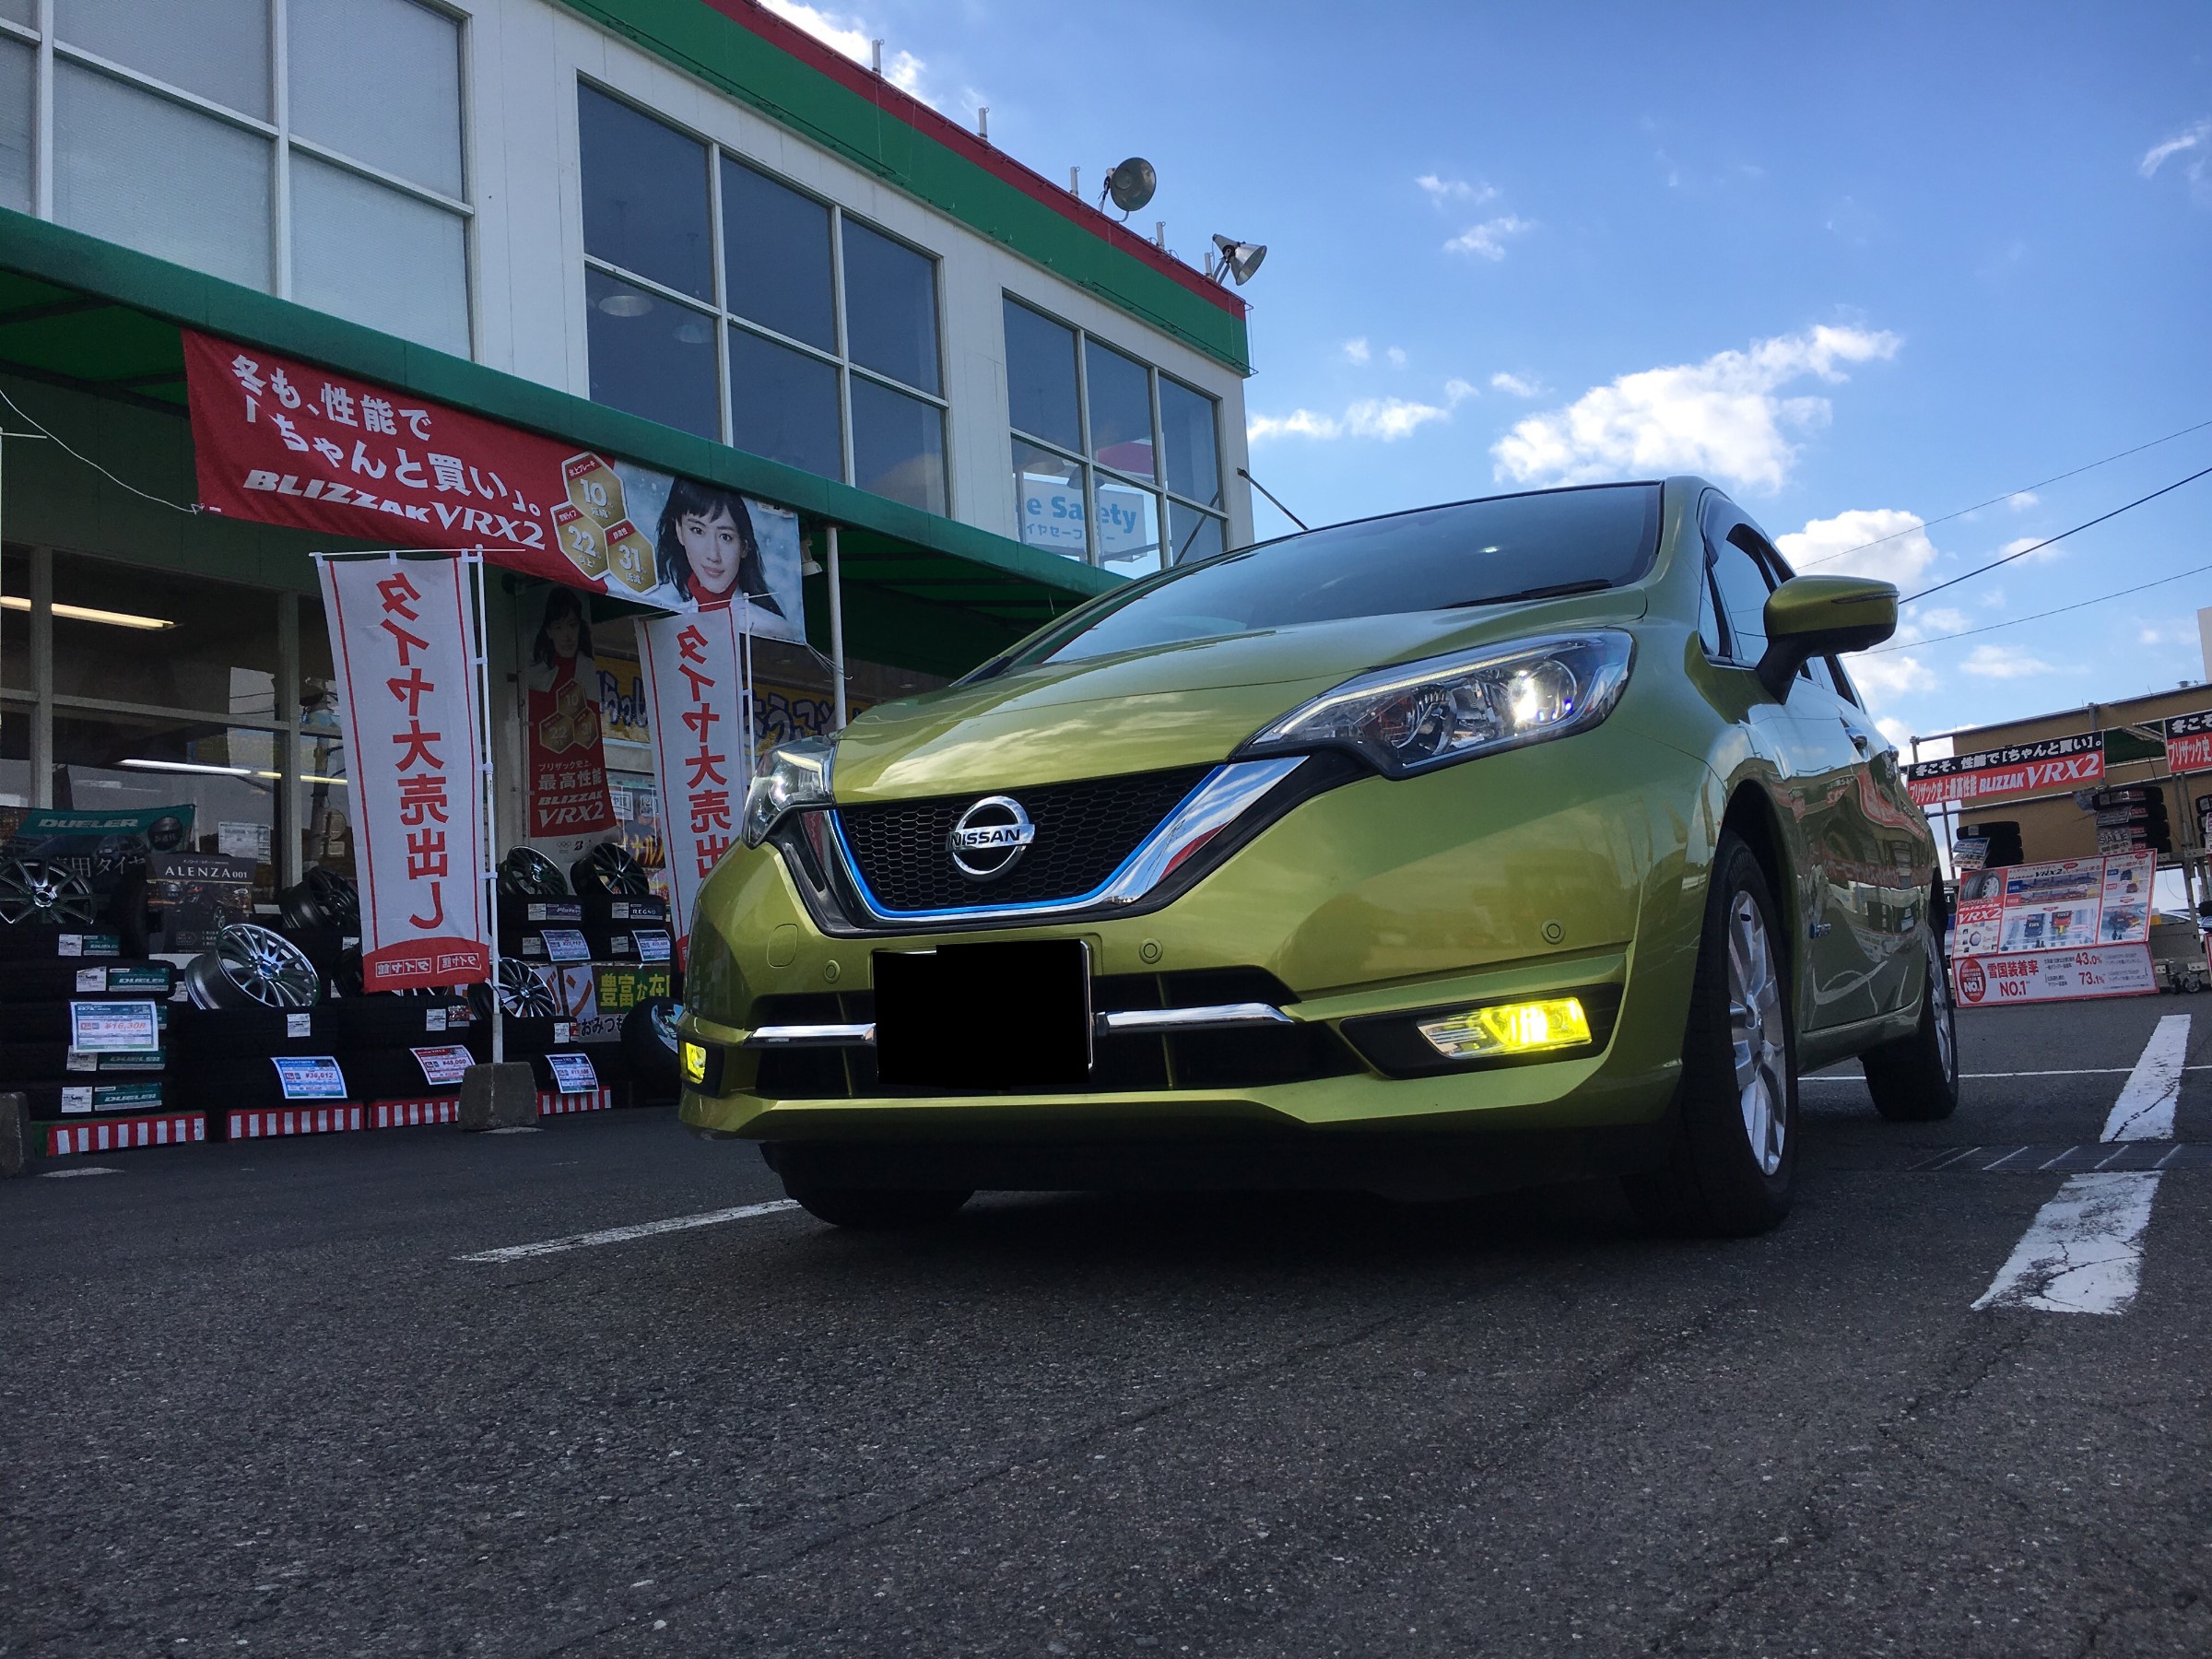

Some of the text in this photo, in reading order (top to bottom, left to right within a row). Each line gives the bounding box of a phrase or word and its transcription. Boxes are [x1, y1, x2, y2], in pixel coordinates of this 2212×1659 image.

[232, 354, 432, 441] 冬も、性能で
[242, 469, 547, 551] BLIZZAK VRX2
[1052, 496, 1137, 534] Saety
[538, 767, 603, 791] 最高性能
[1979, 771, 2025, 794] BLIZZAK
[2026, 753, 2100, 789] VRX2
[538, 789, 604, 806] BLIZZAK
[38, 818, 139, 829] DUELER
[537, 800, 605, 829] VRX2
[950, 829, 1020, 847] NISSAN
[165, 865, 248, 879] ALENZA 001
[1958, 907, 2003, 925] VRX2
[1986, 959, 2040, 979] 雪国装着率
[1999, 980, 2028, 996] NO.1
[104, 1093, 157, 1102] DUELER
